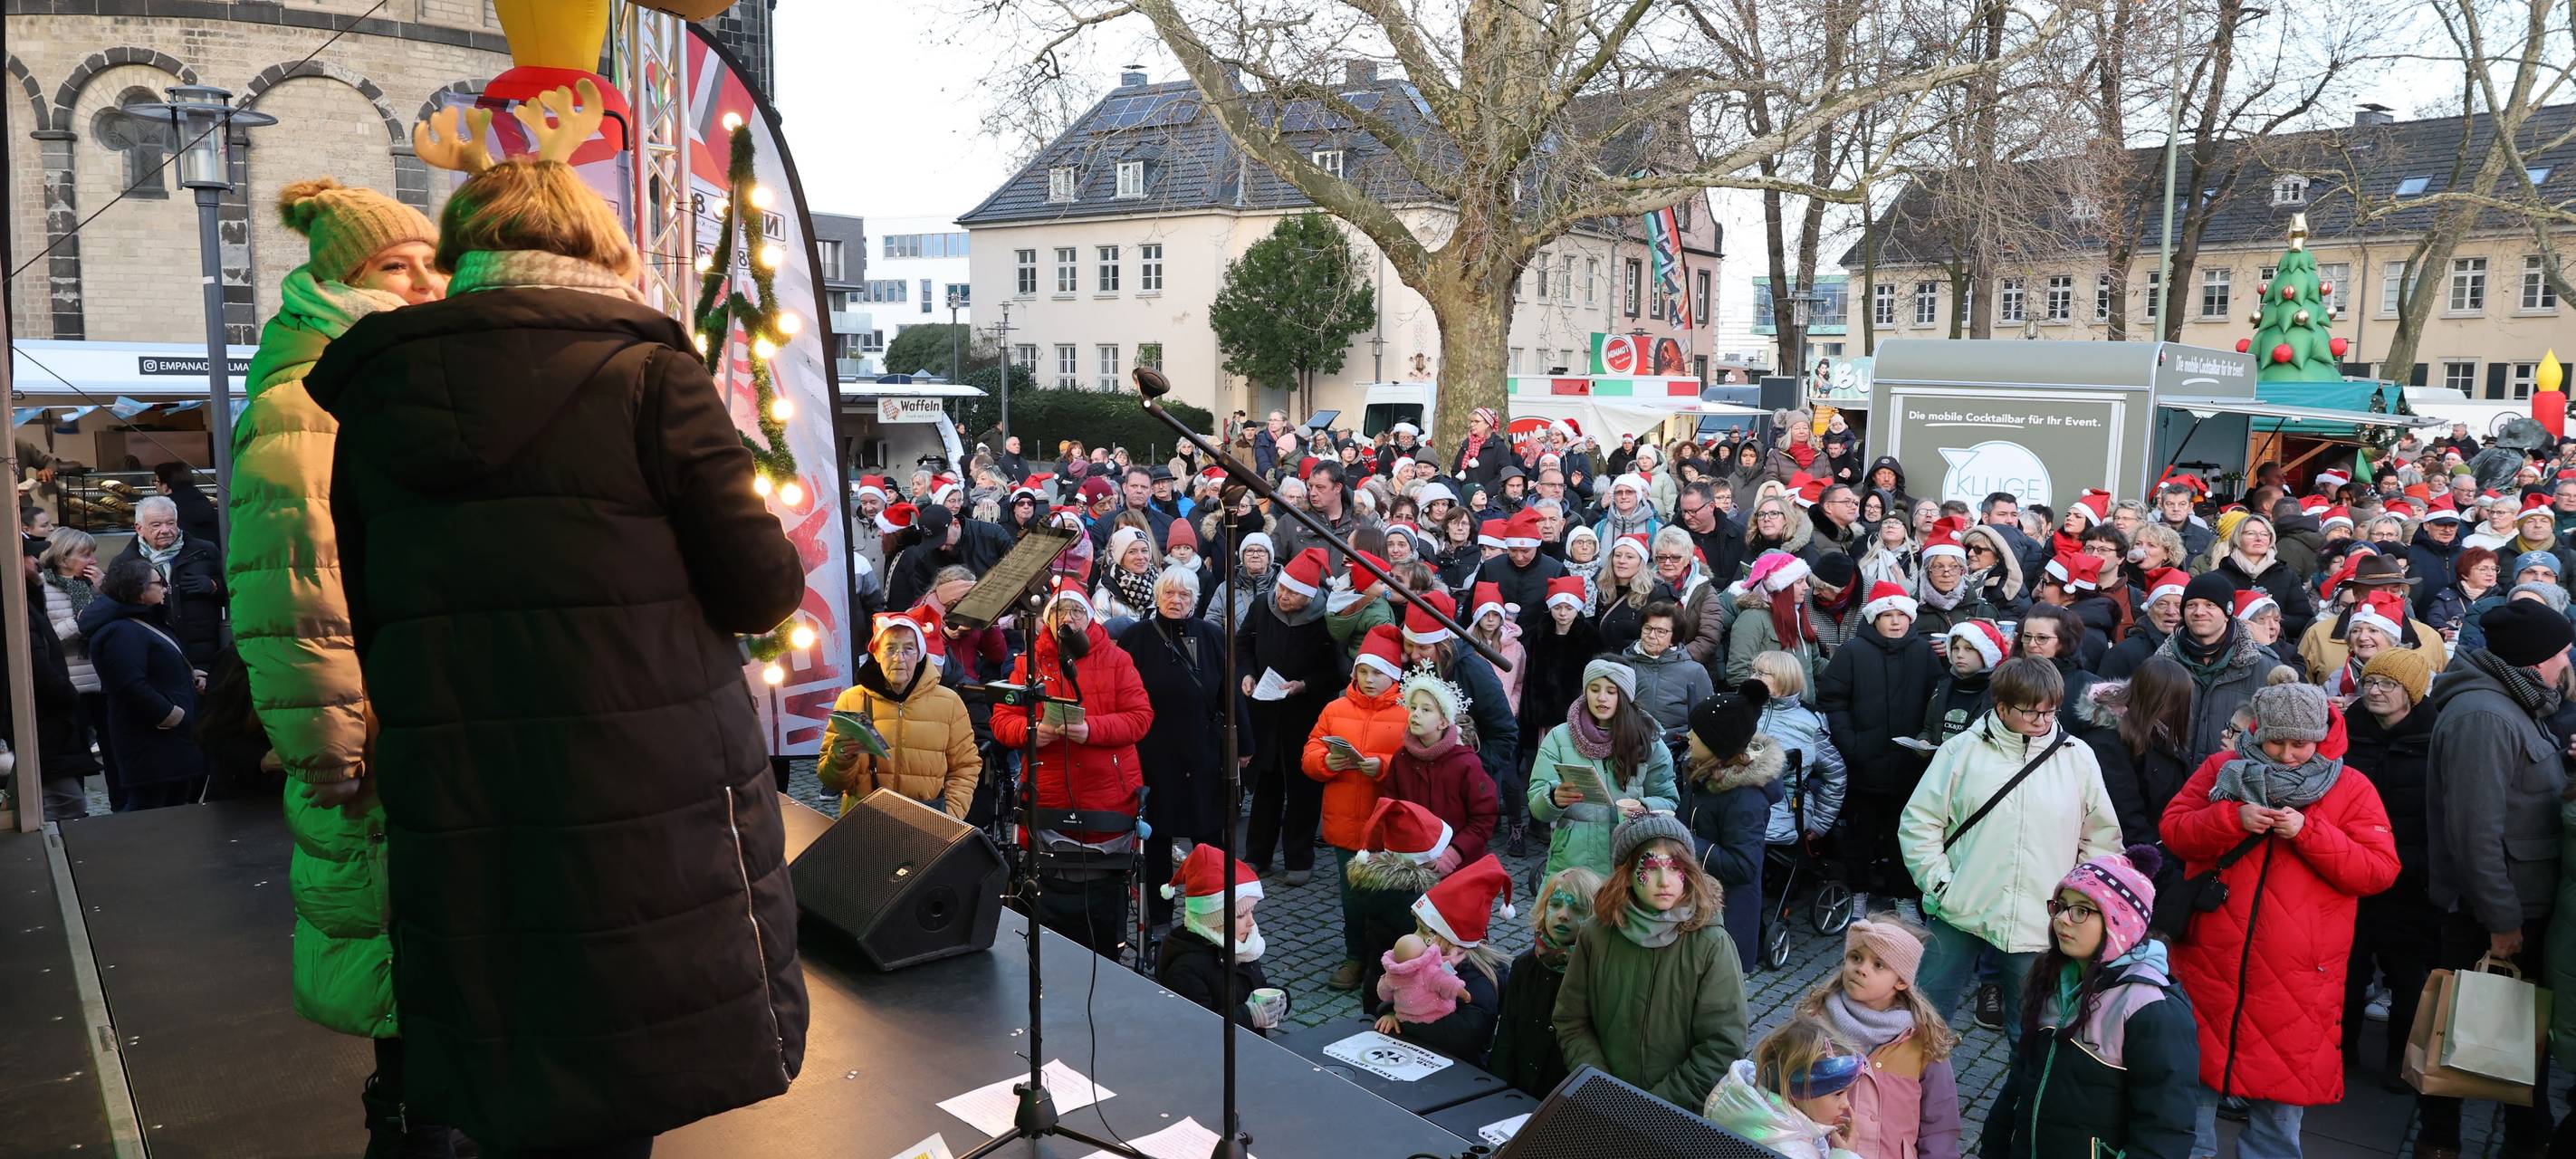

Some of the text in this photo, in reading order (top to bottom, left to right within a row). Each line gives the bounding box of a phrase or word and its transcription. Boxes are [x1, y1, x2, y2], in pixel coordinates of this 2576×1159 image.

[900, 398, 940, 412] Waffeln
[1908, 410, 2102, 427] Die mobile Cocktailbar für Ihr Event.
[1951, 474, 2041, 501] KLUGE
